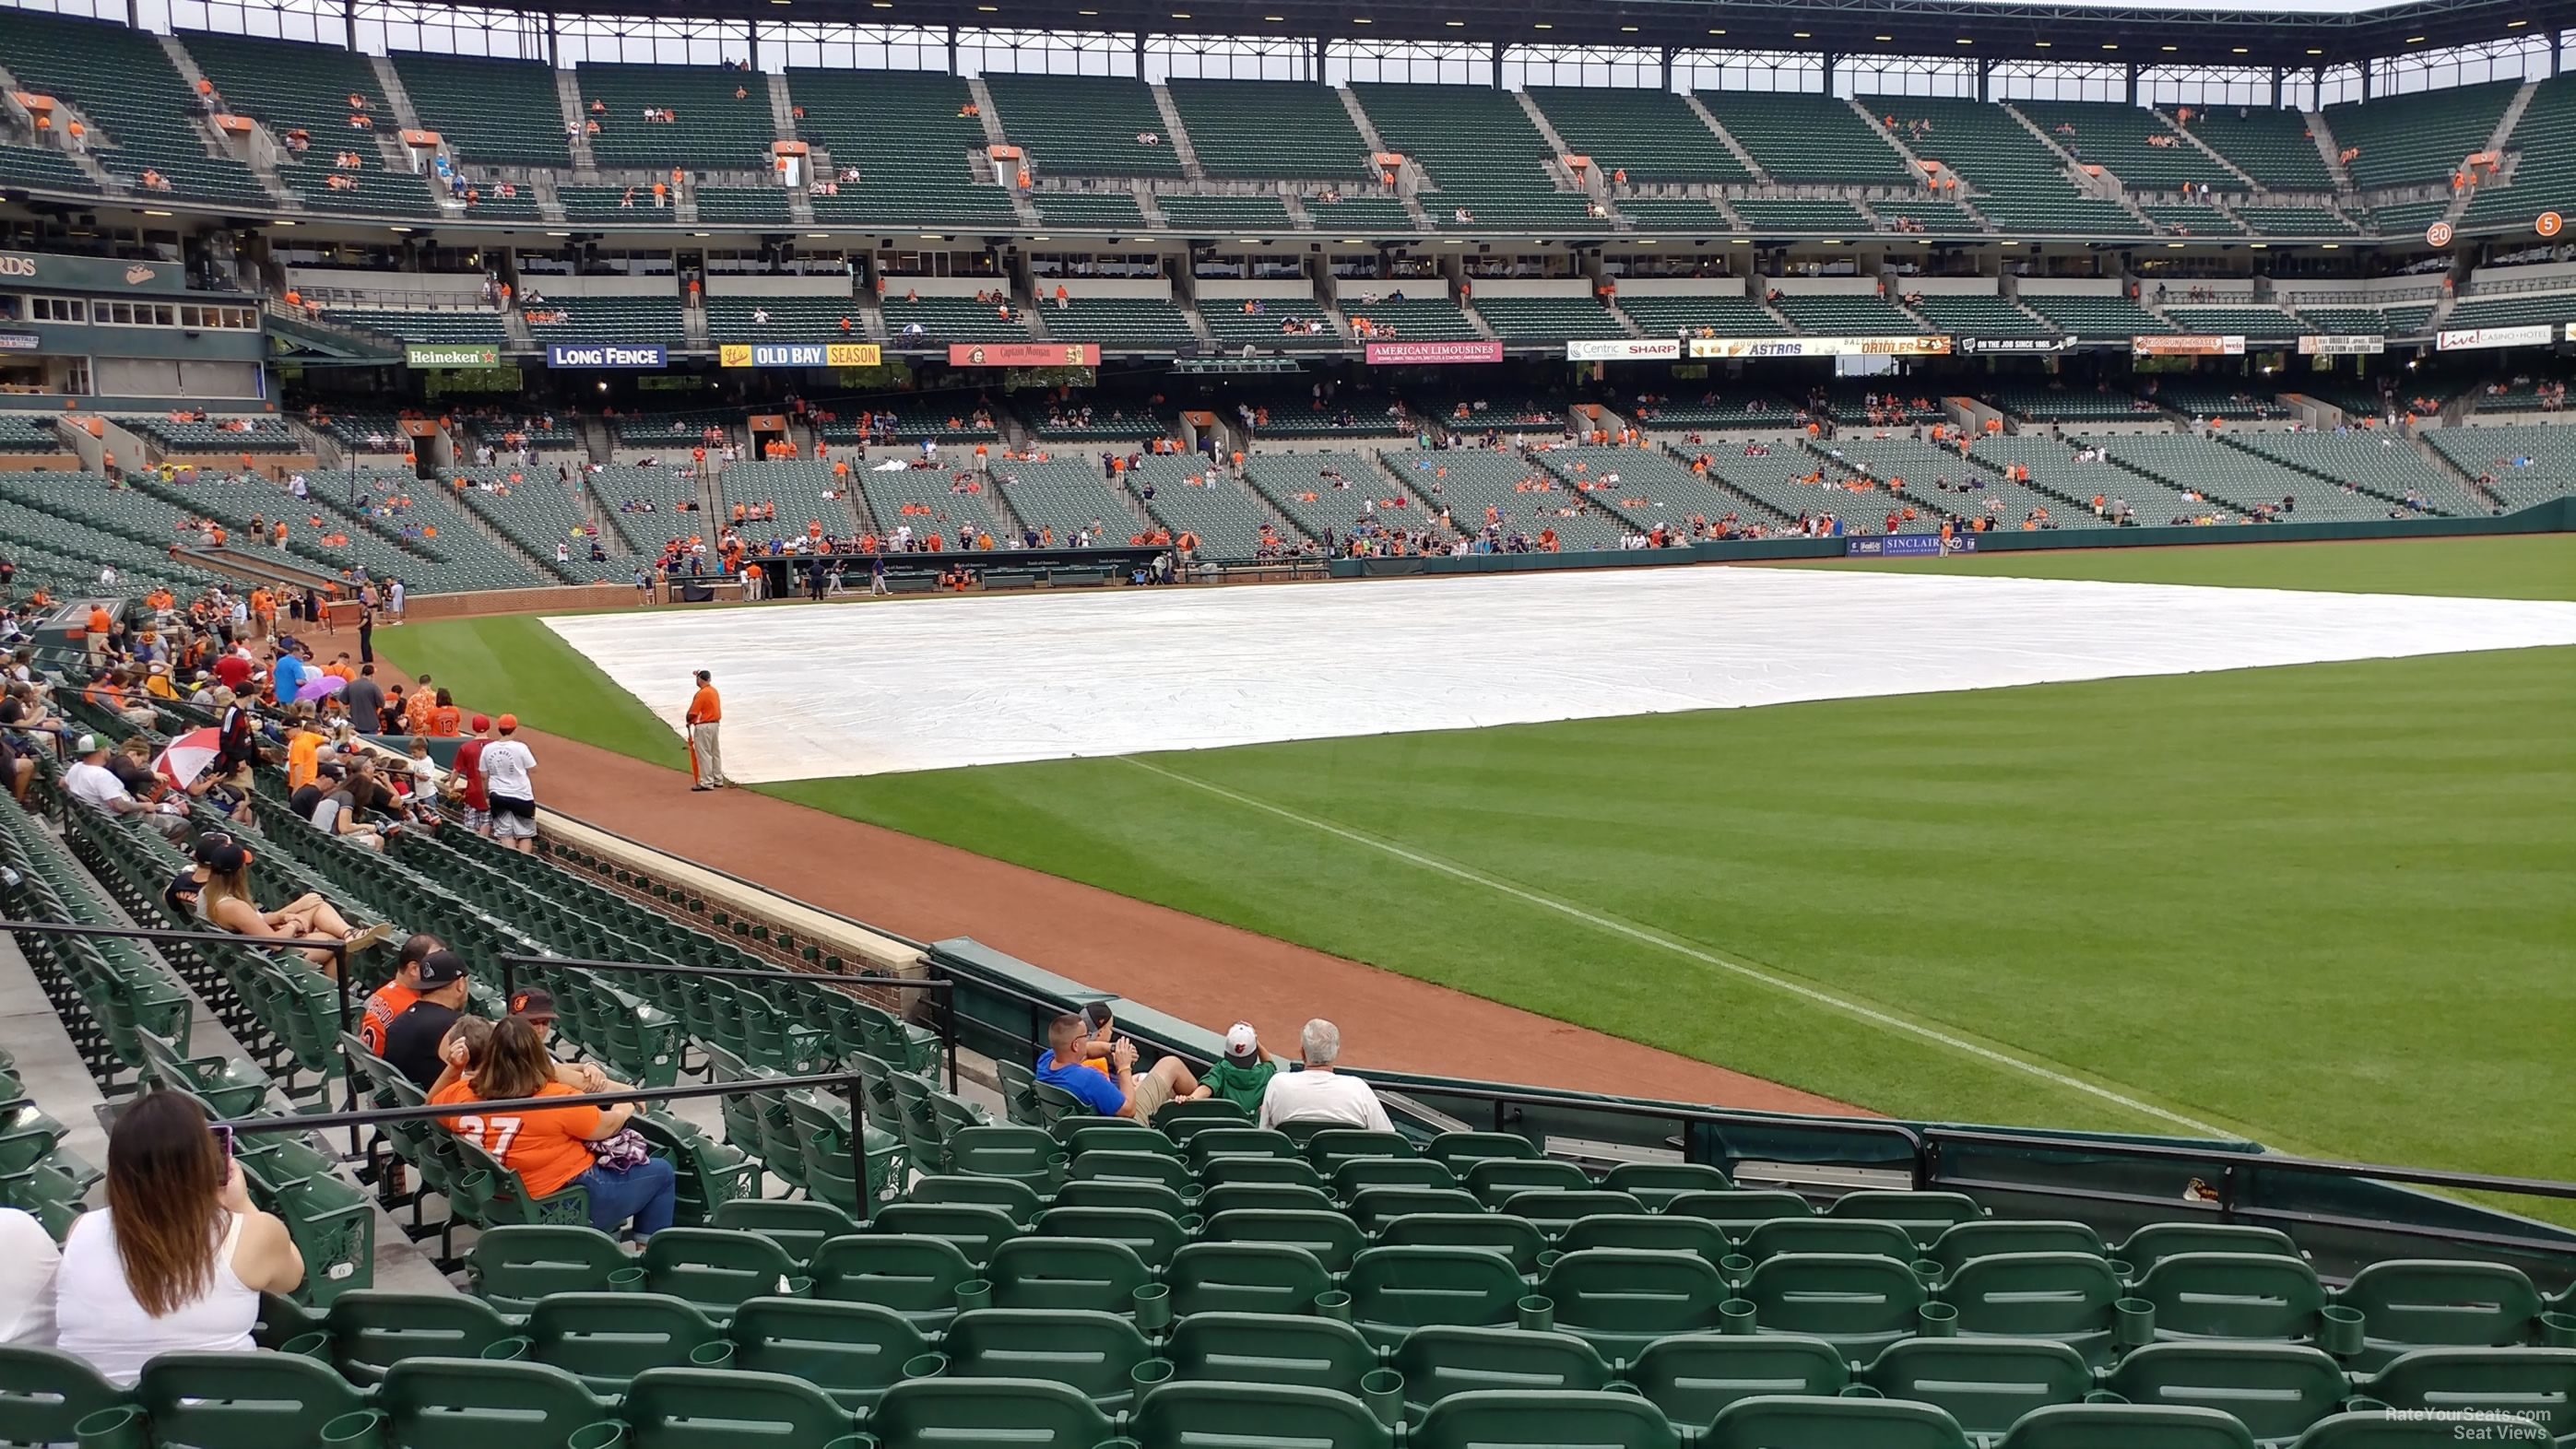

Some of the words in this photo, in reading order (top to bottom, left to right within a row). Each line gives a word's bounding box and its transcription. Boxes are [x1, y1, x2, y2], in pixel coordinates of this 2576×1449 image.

[2544, 217, 2553, 230] 5
[2431, 228, 2448, 241] 20
[2440, 329, 2480, 349] Live!
[2481, 333, 2514, 341] CASINO
[2520, 331, 2546, 339] HOTEL
[1583, 343, 1620, 354] Centric
[1861, 342, 1915, 354] ORIOLES
[1978, 340, 1987, 348] ON
[1988, 340, 2000, 348] THE
[2001, 340, 2014, 348] JOB
[2015, 340, 2034, 348] SINCE
[2148, 338, 2164, 347] KIDS
[2165, 338, 2179, 347] RUN
[2181, 338, 2193, 347] THE
[2194, 338, 2217, 347] BASES
[832, 348, 876, 363] SEASON
[1000, 346, 1024, 358] Captain
[1025, 346, 1051, 358] Morgan
[1374, 346, 1428, 356] AMERICAN
[1431, 345, 1494, 355] LIMOUSINES
[1629, 345, 1676, 354] SHARP
[1749, 343, 1802, 356] ASTROS
[410, 350, 479, 363] Heineken
[556, 348, 603, 364] LONG
[606, 348, 658, 364] FENCE
[757, 348, 787, 364] OLD
[1886, 537, 1940, 548] SINCLAIR
[441, 720, 454, 734] 13
[338, 1266, 345, 1276] 6
